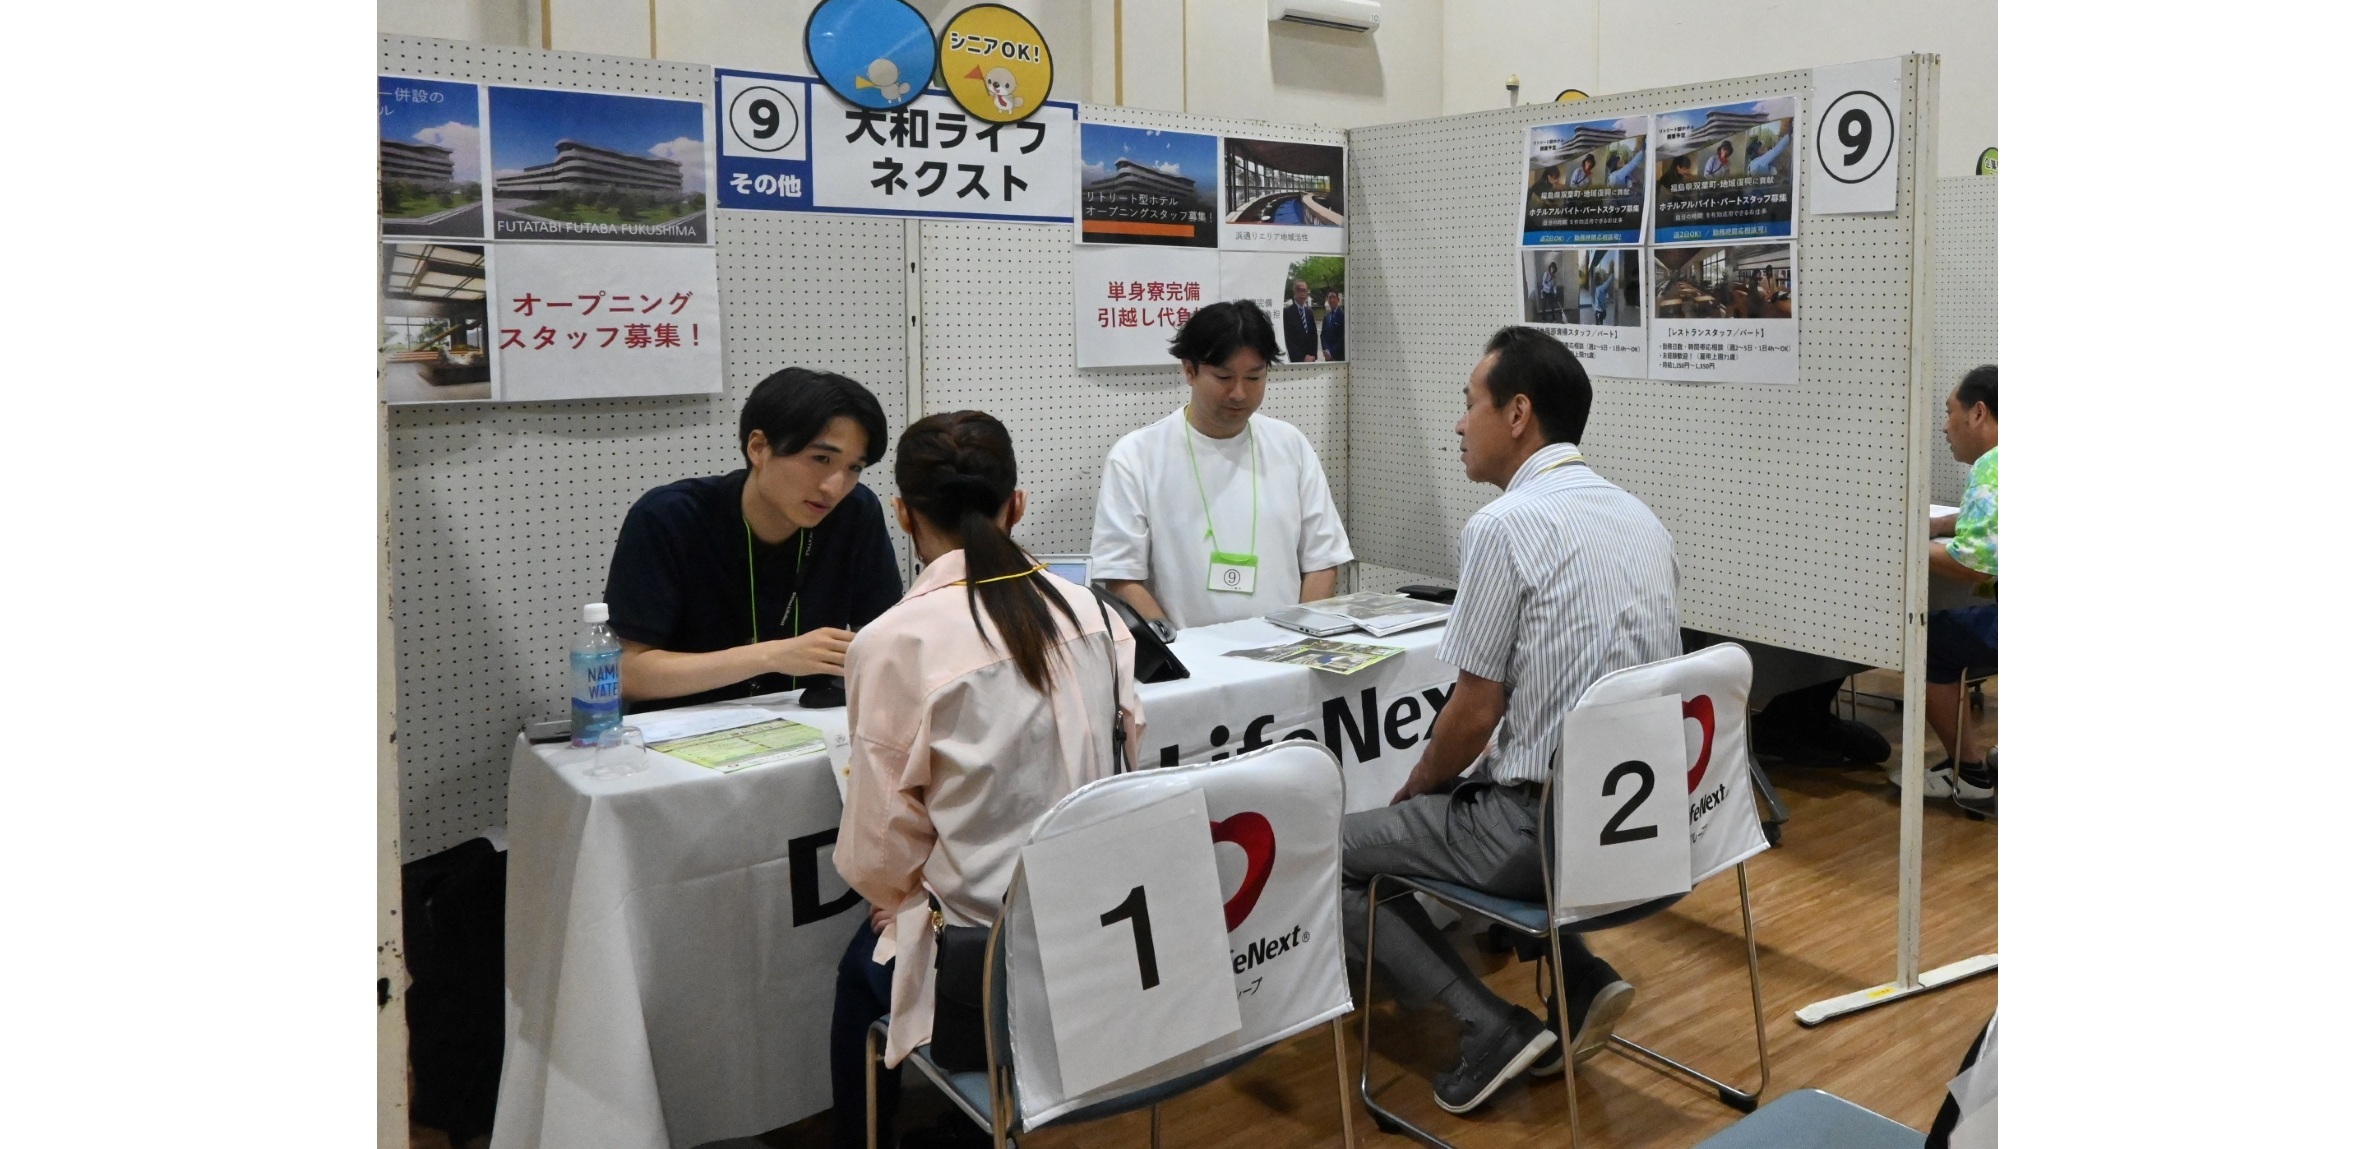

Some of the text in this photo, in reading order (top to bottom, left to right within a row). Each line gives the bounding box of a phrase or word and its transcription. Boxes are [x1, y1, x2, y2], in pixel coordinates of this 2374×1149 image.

[845, 106, 1046, 155] 大和ライフ
[729, 172, 802, 198] その他
[870, 157, 1029, 202] ネクスト
[1087, 191, 1178, 206] リトリート型ホテル
[497, 220, 697, 237] FUTATABI FUTABA FUKUSHIMA
[512, 290, 694, 317] オープニング
[1107, 281, 1200, 302] 単身寮完備
[1097, 306, 1201, 328] 引越し代負
[499, 322, 700, 350] スタッフ募集！
[1600, 760, 1658, 846] 2
[1100, 885, 1160, 991] 1
